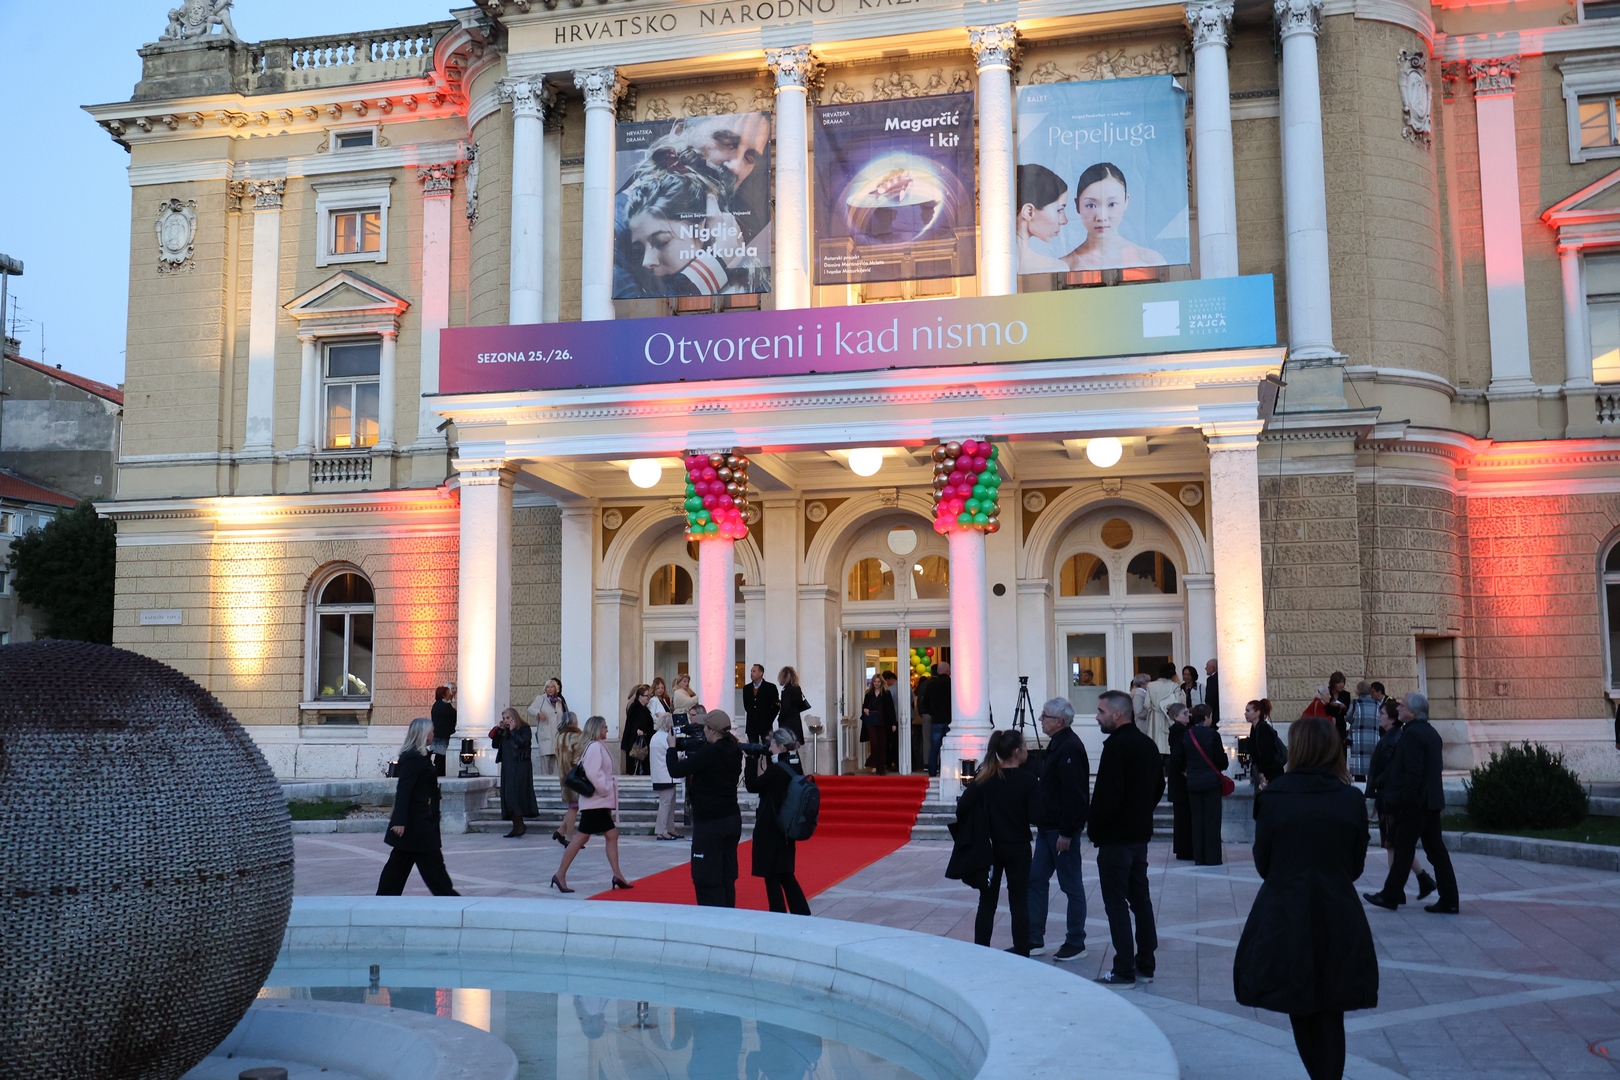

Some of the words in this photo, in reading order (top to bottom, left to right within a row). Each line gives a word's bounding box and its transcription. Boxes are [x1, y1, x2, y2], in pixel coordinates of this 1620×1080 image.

[555, 13, 677, 44] HRVATSKO
[700, 0, 836, 28] NARODNO
[822, 110, 851, 118] HRVATSKA
[884, 110, 959, 132] Magarčić
[929, 133, 934, 147] i
[938, 132, 960, 147] kit
[1048, 122, 1156, 151] Pepeljuga
[680, 222, 743, 242] Nigdje,
[680, 241, 758, 260] niotkuda
[1189, 319, 1227, 328] ZAJCA
[1189, 327, 1227, 335] RIJEKA
[644, 324, 803, 366] Otvoreni
[816, 323, 823, 357] i
[835, 317, 899, 356] kad
[912, 316, 1029, 351] nismo
[477, 351, 526, 364] SEZONA
[528, 349, 574, 364] 25./26.
